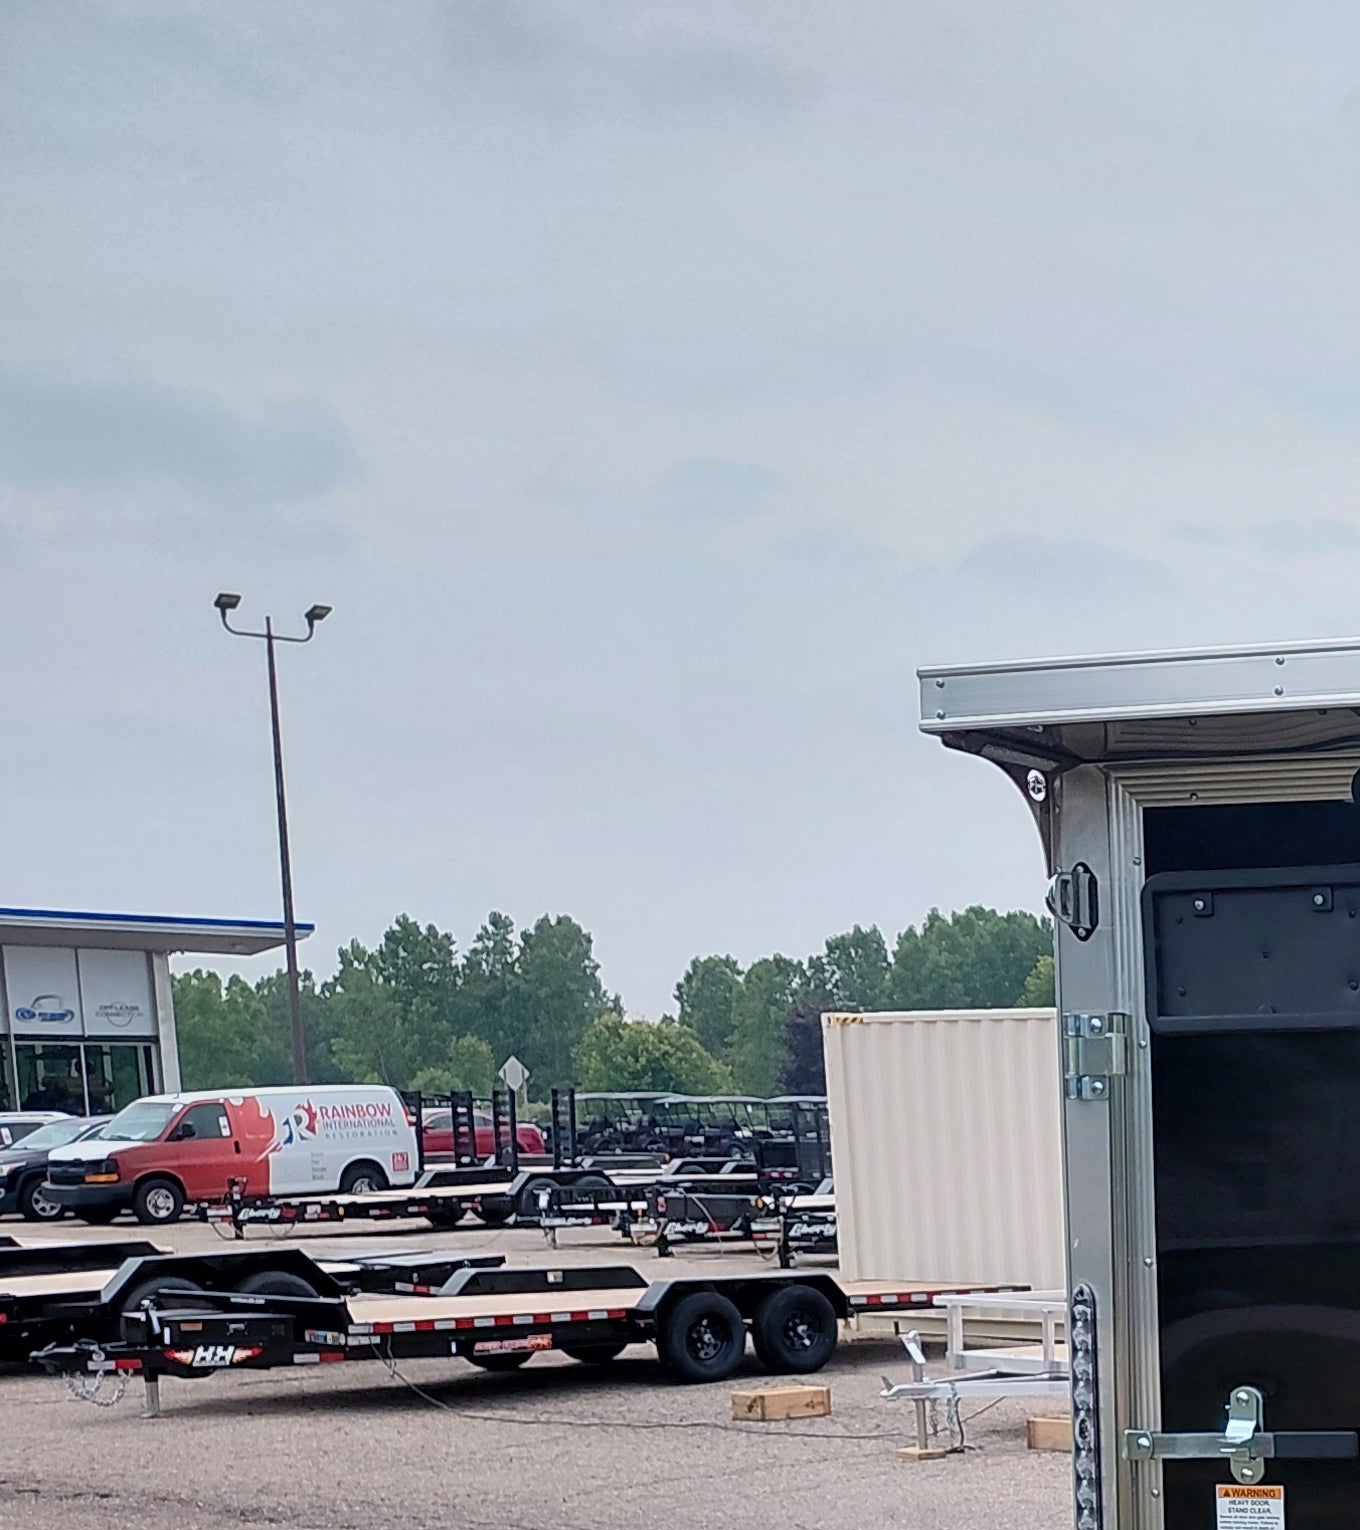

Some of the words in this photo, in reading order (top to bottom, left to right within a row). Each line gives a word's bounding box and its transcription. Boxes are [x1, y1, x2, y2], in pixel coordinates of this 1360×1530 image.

[319, 1103, 391, 1120] RAINBOW
[323, 1118, 395, 1131] INTERNATIONAL
[325, 1130, 398, 1140] RESTORATION
[237, 1207, 281, 1220] Liberty
[1231, 1488, 1276, 1498] WARNING
